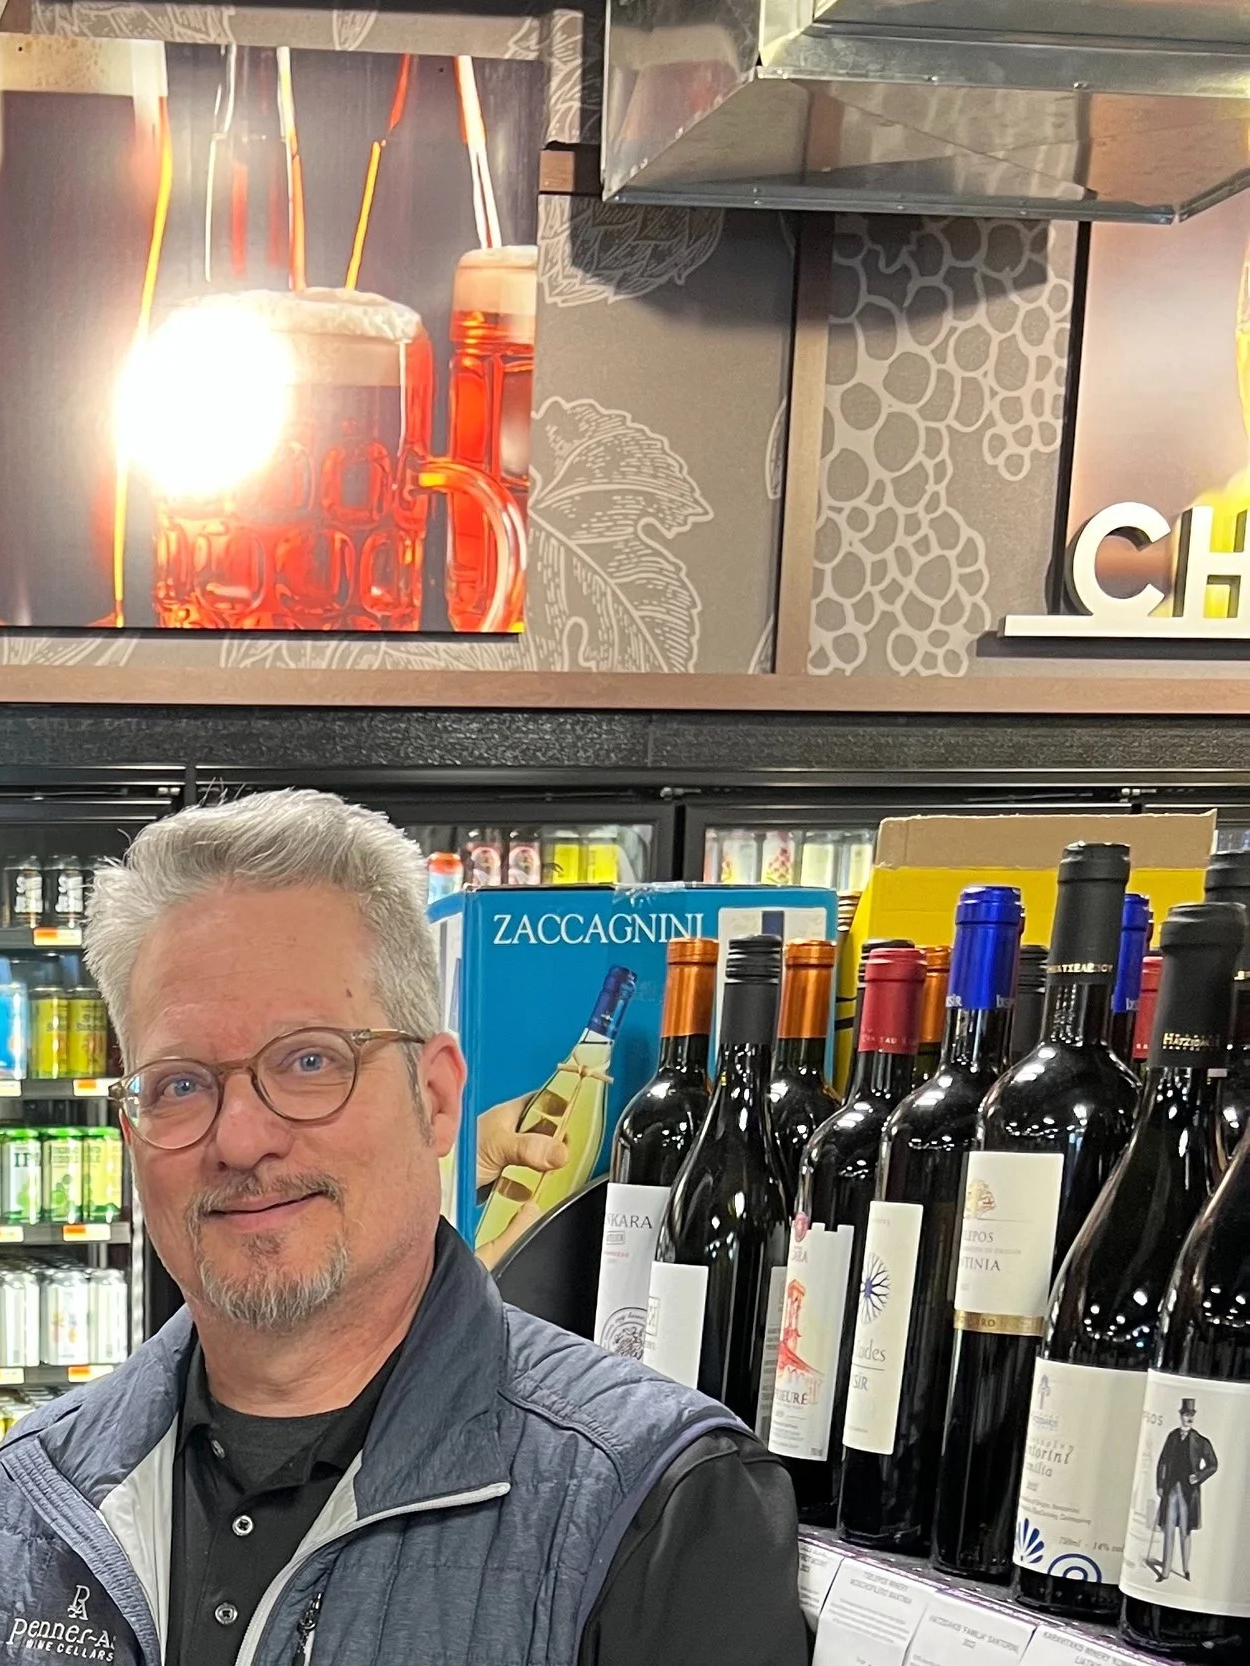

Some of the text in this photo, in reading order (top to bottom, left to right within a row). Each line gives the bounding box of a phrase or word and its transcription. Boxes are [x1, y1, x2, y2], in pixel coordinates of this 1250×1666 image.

[493, 914, 707, 945] ZACCAGNINI
[26, 1639, 114, 1662] WINE CELLARS
